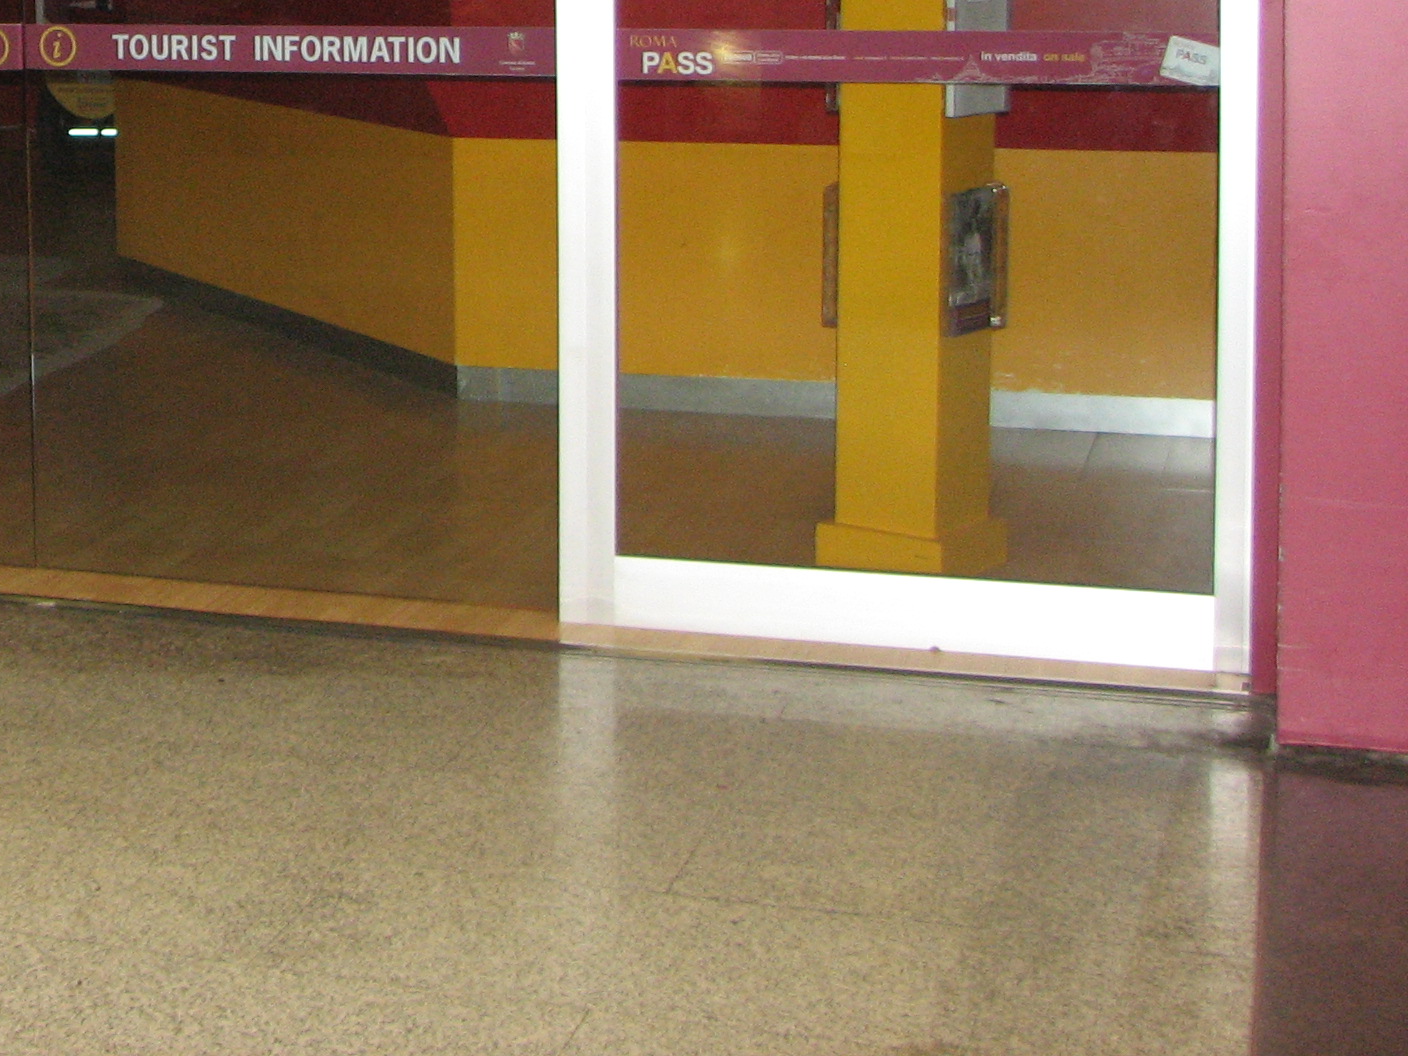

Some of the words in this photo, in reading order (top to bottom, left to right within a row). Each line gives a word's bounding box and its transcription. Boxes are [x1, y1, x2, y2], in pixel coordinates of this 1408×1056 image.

[112, 33, 236, 61] TOURIST
[254, 34, 460, 63] INFORMATION
[630, 35, 678, 47] ROMA
[642, 51, 713, 74] PASS
[1176, 48, 1207, 65] PASS
